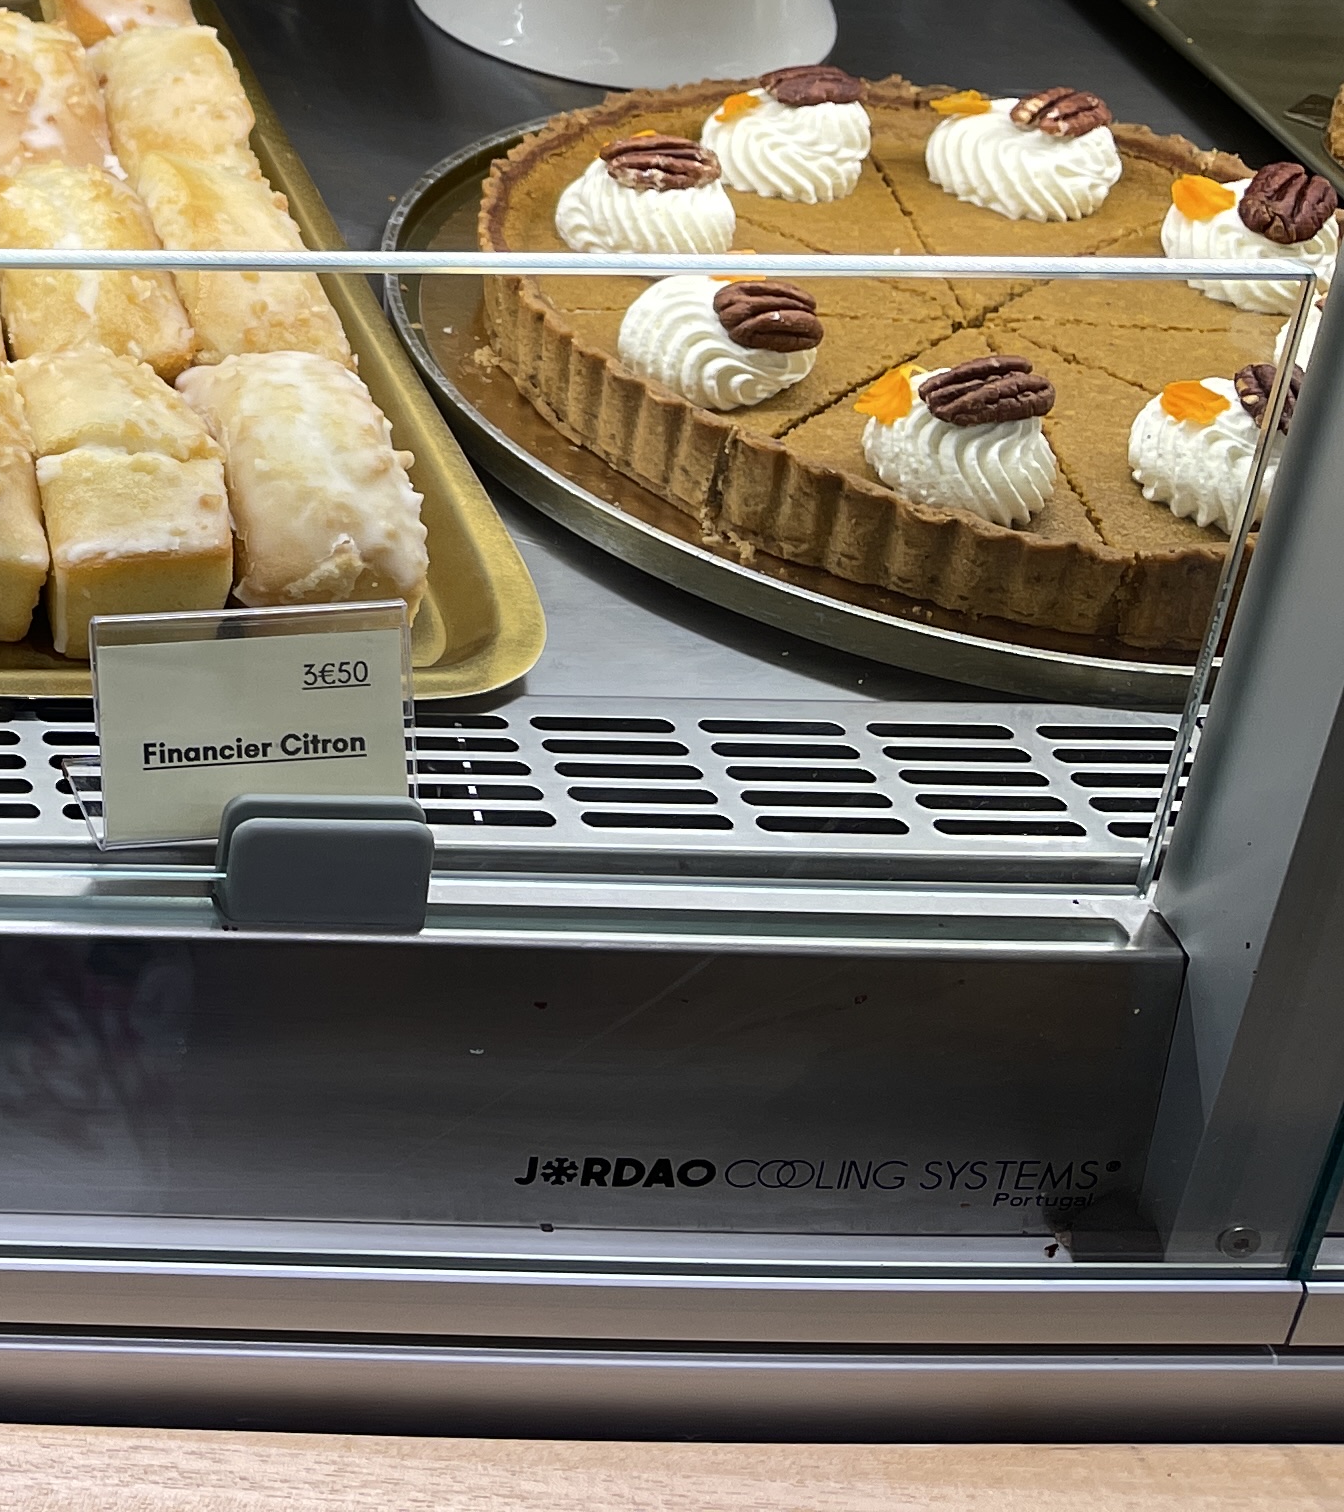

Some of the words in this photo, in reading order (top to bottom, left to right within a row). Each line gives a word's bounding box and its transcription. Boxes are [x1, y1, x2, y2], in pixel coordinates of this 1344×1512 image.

[303, 660, 369, 687] 3€50
[143, 737, 273, 765] Financier
[280, 733, 366, 757] Citron
[724, 1159, 909, 1190] COOLING
[992, 1192, 1094, 1211] Portugal
